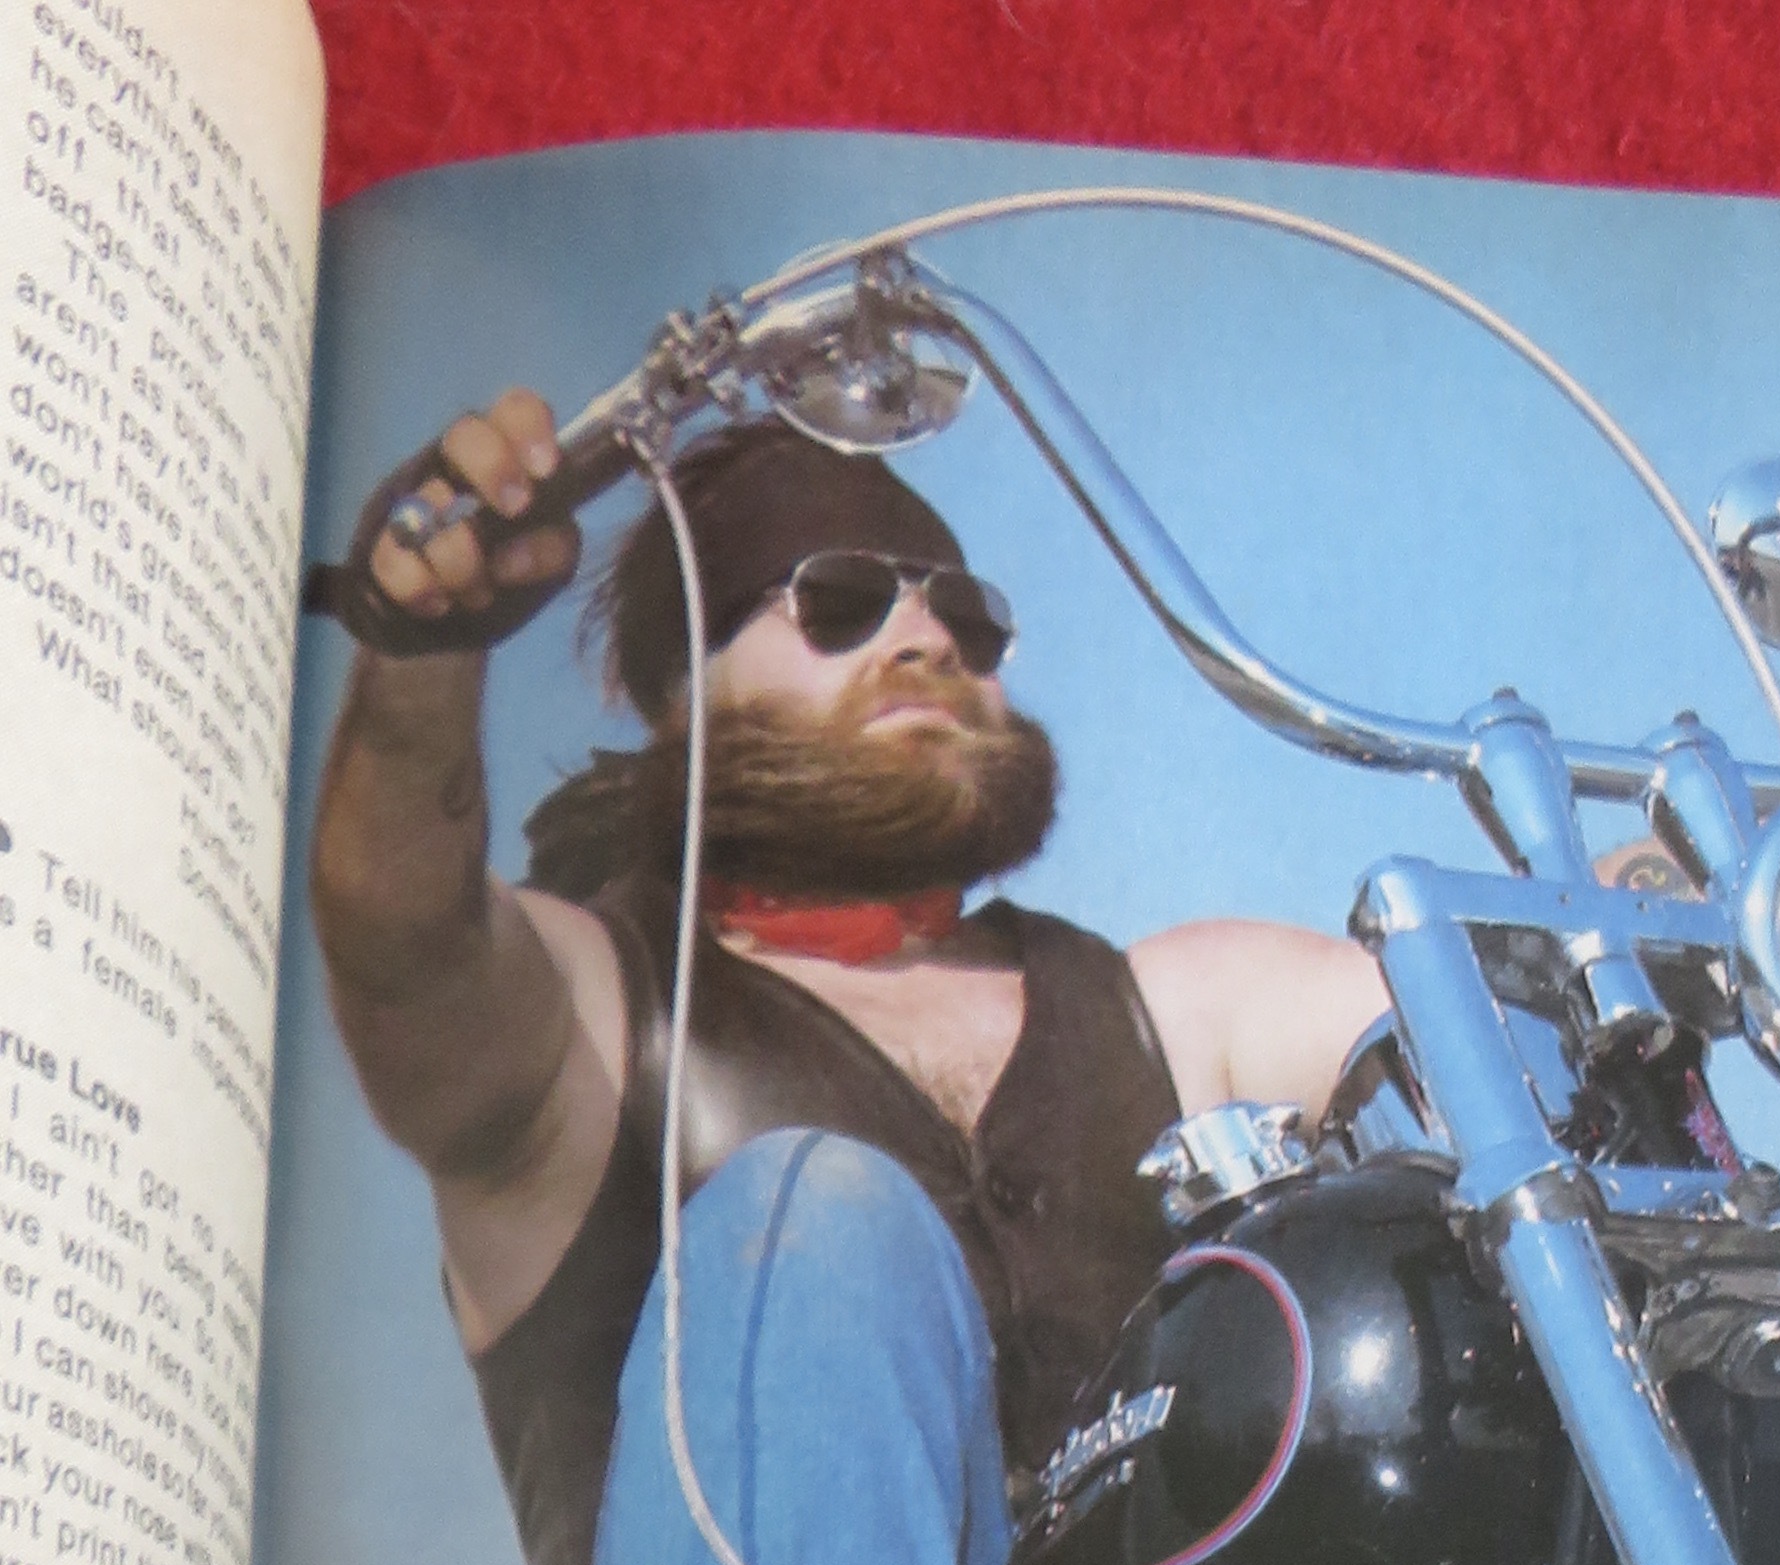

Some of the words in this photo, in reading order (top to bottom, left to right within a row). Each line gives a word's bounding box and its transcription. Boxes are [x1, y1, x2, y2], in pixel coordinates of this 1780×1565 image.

[36, 619, 122, 711] What
[39, 849, 101, 922] Tell
[111, 899, 162, 967] him
[69, 1057, 140, 1134] Love
[87, 1184, 149, 1252] than
[53, 1284, 137, 1355] down
[35, 1336, 94, 1388] can
[42, 1456, 115, 1511] your
